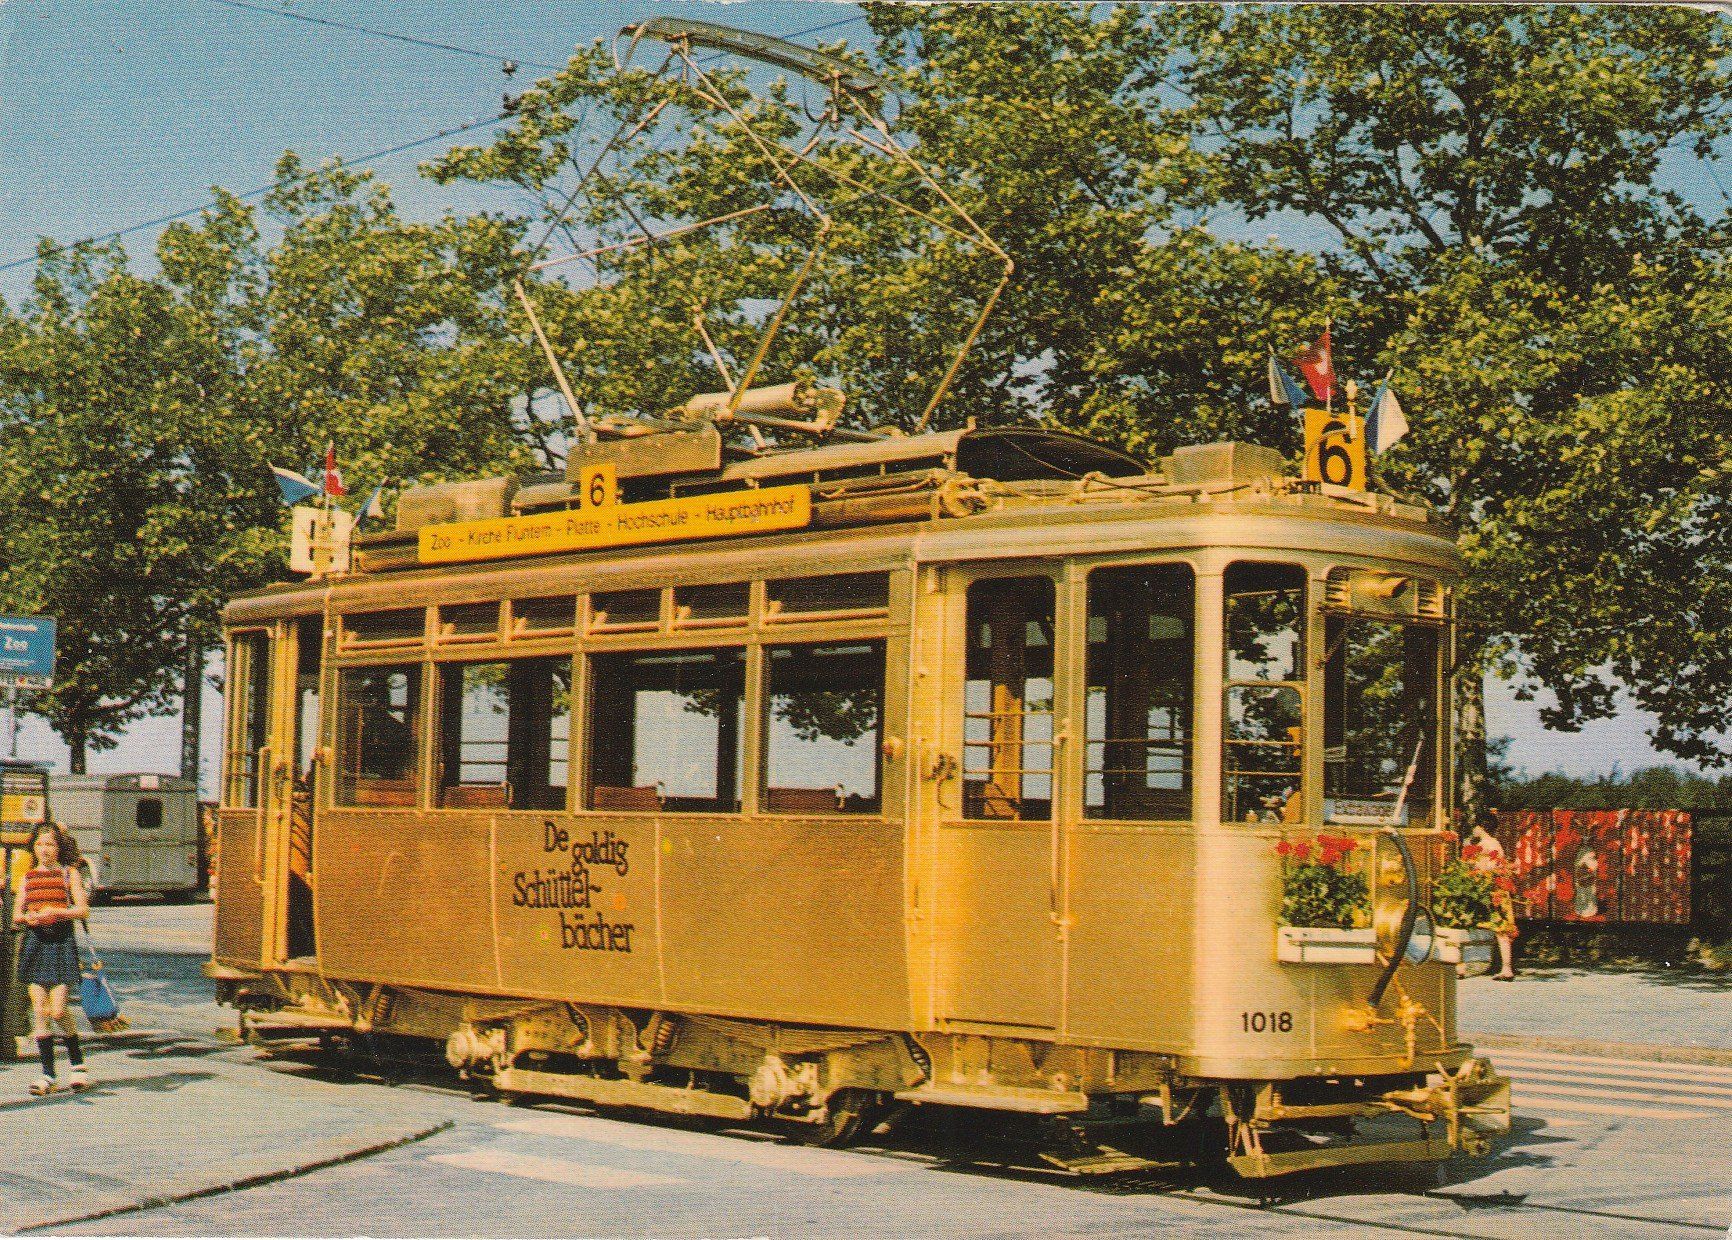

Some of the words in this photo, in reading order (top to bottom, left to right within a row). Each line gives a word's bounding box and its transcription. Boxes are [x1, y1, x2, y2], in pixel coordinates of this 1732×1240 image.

[1319, 420, 1353, 487] 6
[590, 473, 605, 507] 6
[430, 532, 452, 551] Zoo
[468, 528, 502, 546] Kirche
[505, 523, 551, 541] Fluntern
[566, 517, 600, 535] Platte
[617, 509, 688, 531] Hochschule
[706, 494, 795, 525] Hauptbahnhof
[544, 820, 568, 852] De
[571, 830, 629, 877] goldig
[513, 868, 602, 908] Schüttel-
[559, 911, 634, 952] bächer
[1241, 1011, 1293, 1033] 1018
